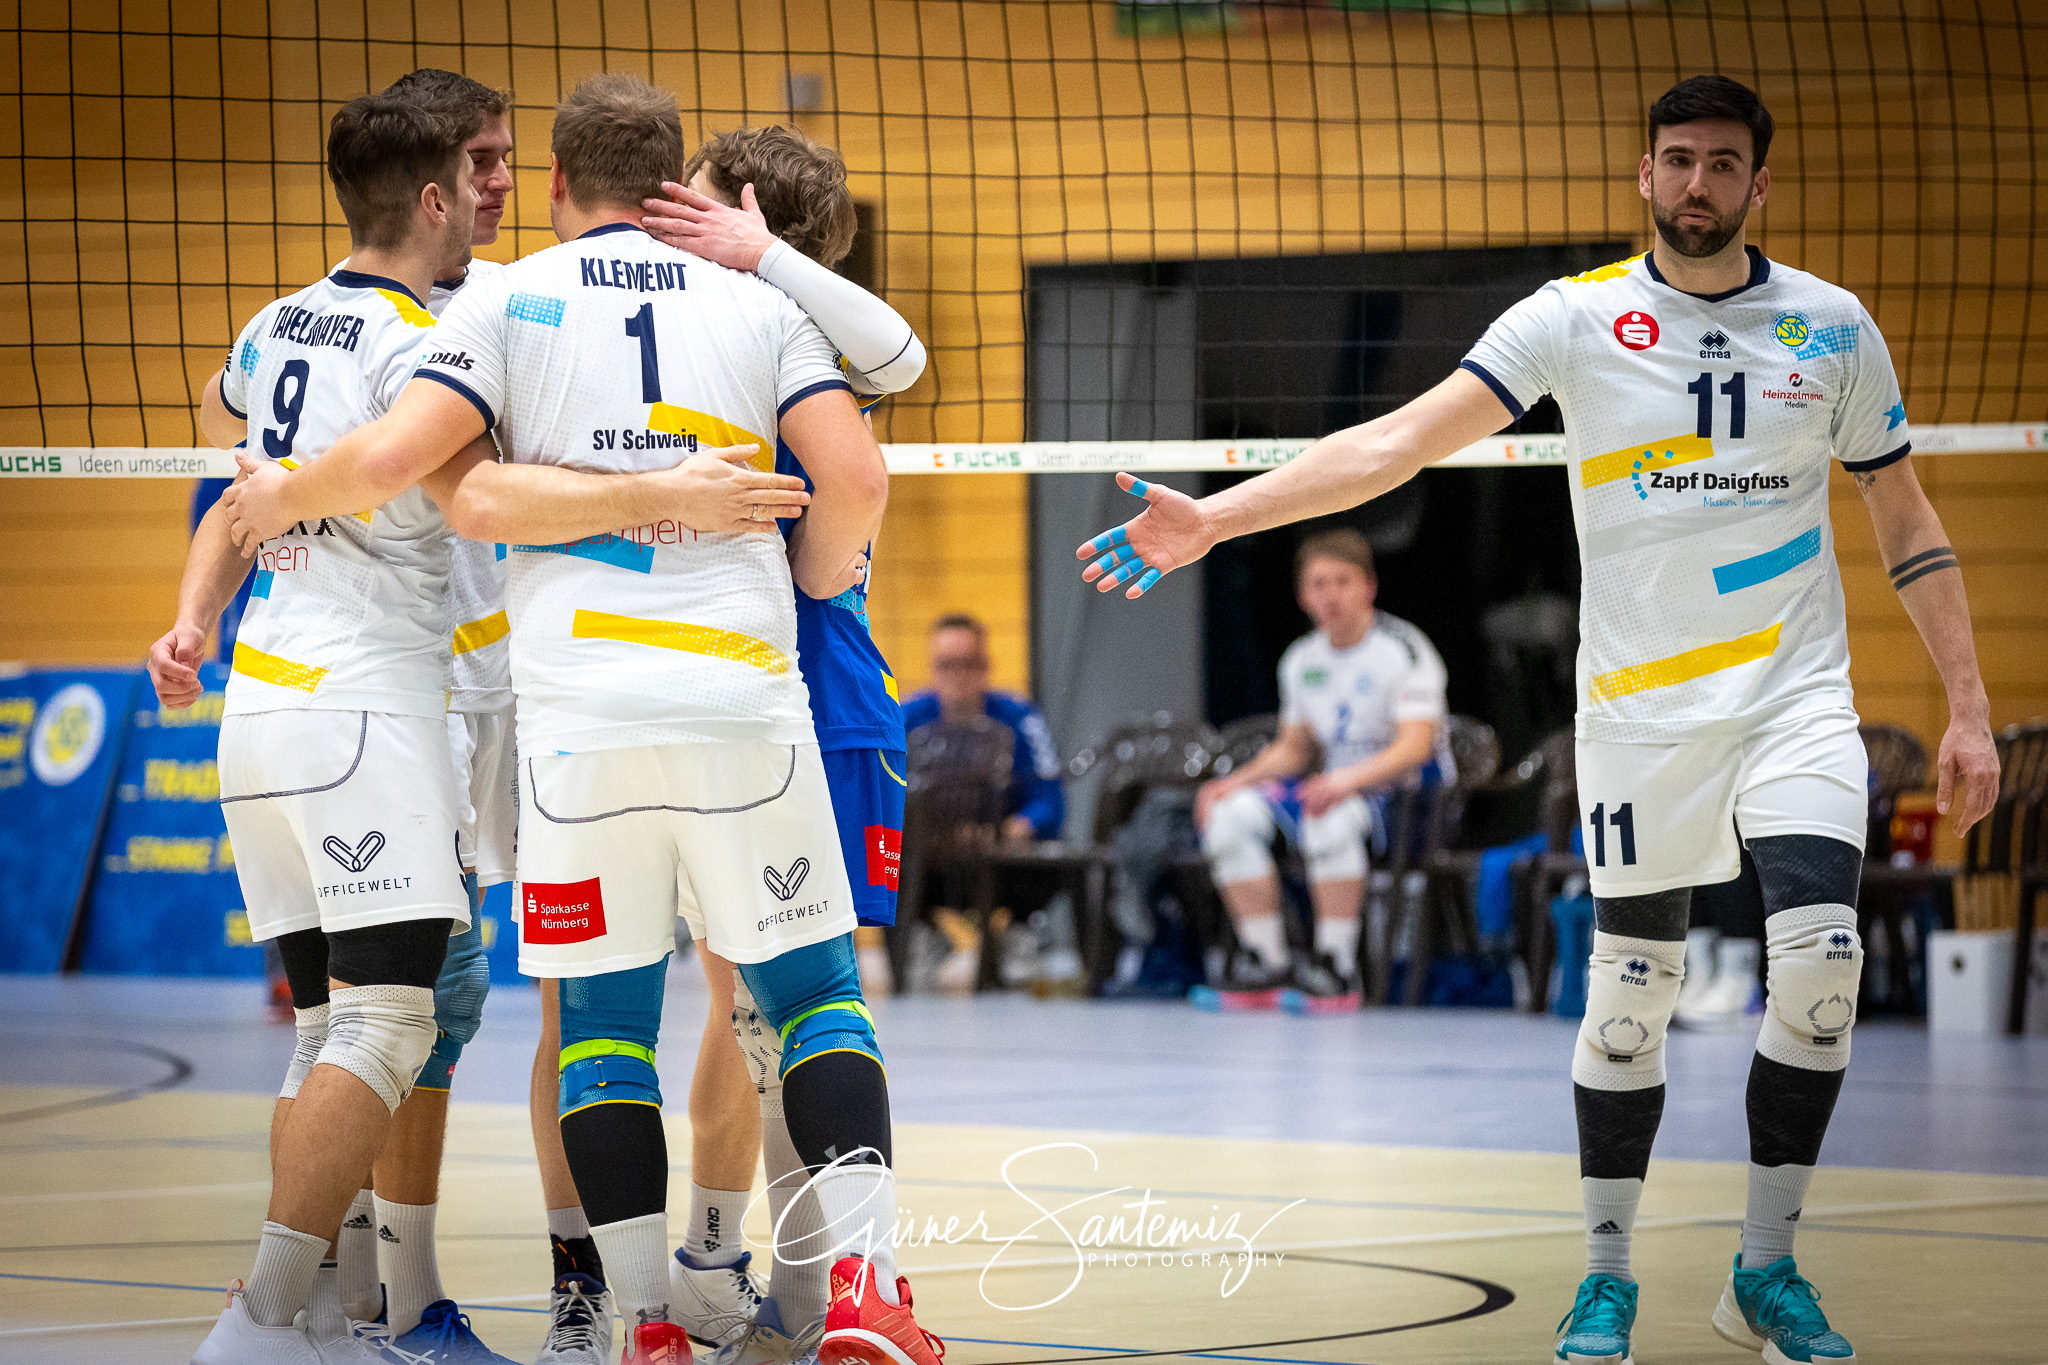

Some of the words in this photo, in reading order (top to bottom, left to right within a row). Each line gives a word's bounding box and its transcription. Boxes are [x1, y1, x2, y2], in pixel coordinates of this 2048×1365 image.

[580, 257, 687, 293] KLEMENT
[625, 302, 663, 404] 1
[1699, 350, 1731, 359] errea
[1762, 389, 1824, 401] Heinzelmann
[263, 359, 310, 458] 9
[1688, 372, 1746, 439] 11
[1784, 401, 1808, 409] Medien
[593, 429, 616, 451] SV
[622, 429, 698, 452] Schwaig
[953, 451, 1022, 467] FUCHS
[1246, 447, 1307, 464] FUCH
[1524, 443, 1566, 459] FUC
[0, 455, 62, 472] UCHS
[79, 454, 123, 473] Ideen
[128, 456, 207, 473] umsetzen
[1650, 472, 1699, 493] Zapf
[1703, 472, 1790, 493] Daigfuss
[1703, 496, 1738, 508] Mission
[1590, 802, 1637, 867] 11
[540, 902, 590, 916] Sparkasse
[758, 900, 828, 931] OFFICEWELT
[541, 917, 589, 929] Nürnberg
[1826, 950, 1852, 960] errea
[1620, 973, 1648, 986] errea
[707, 1206, 720, 1240] CRAFT
